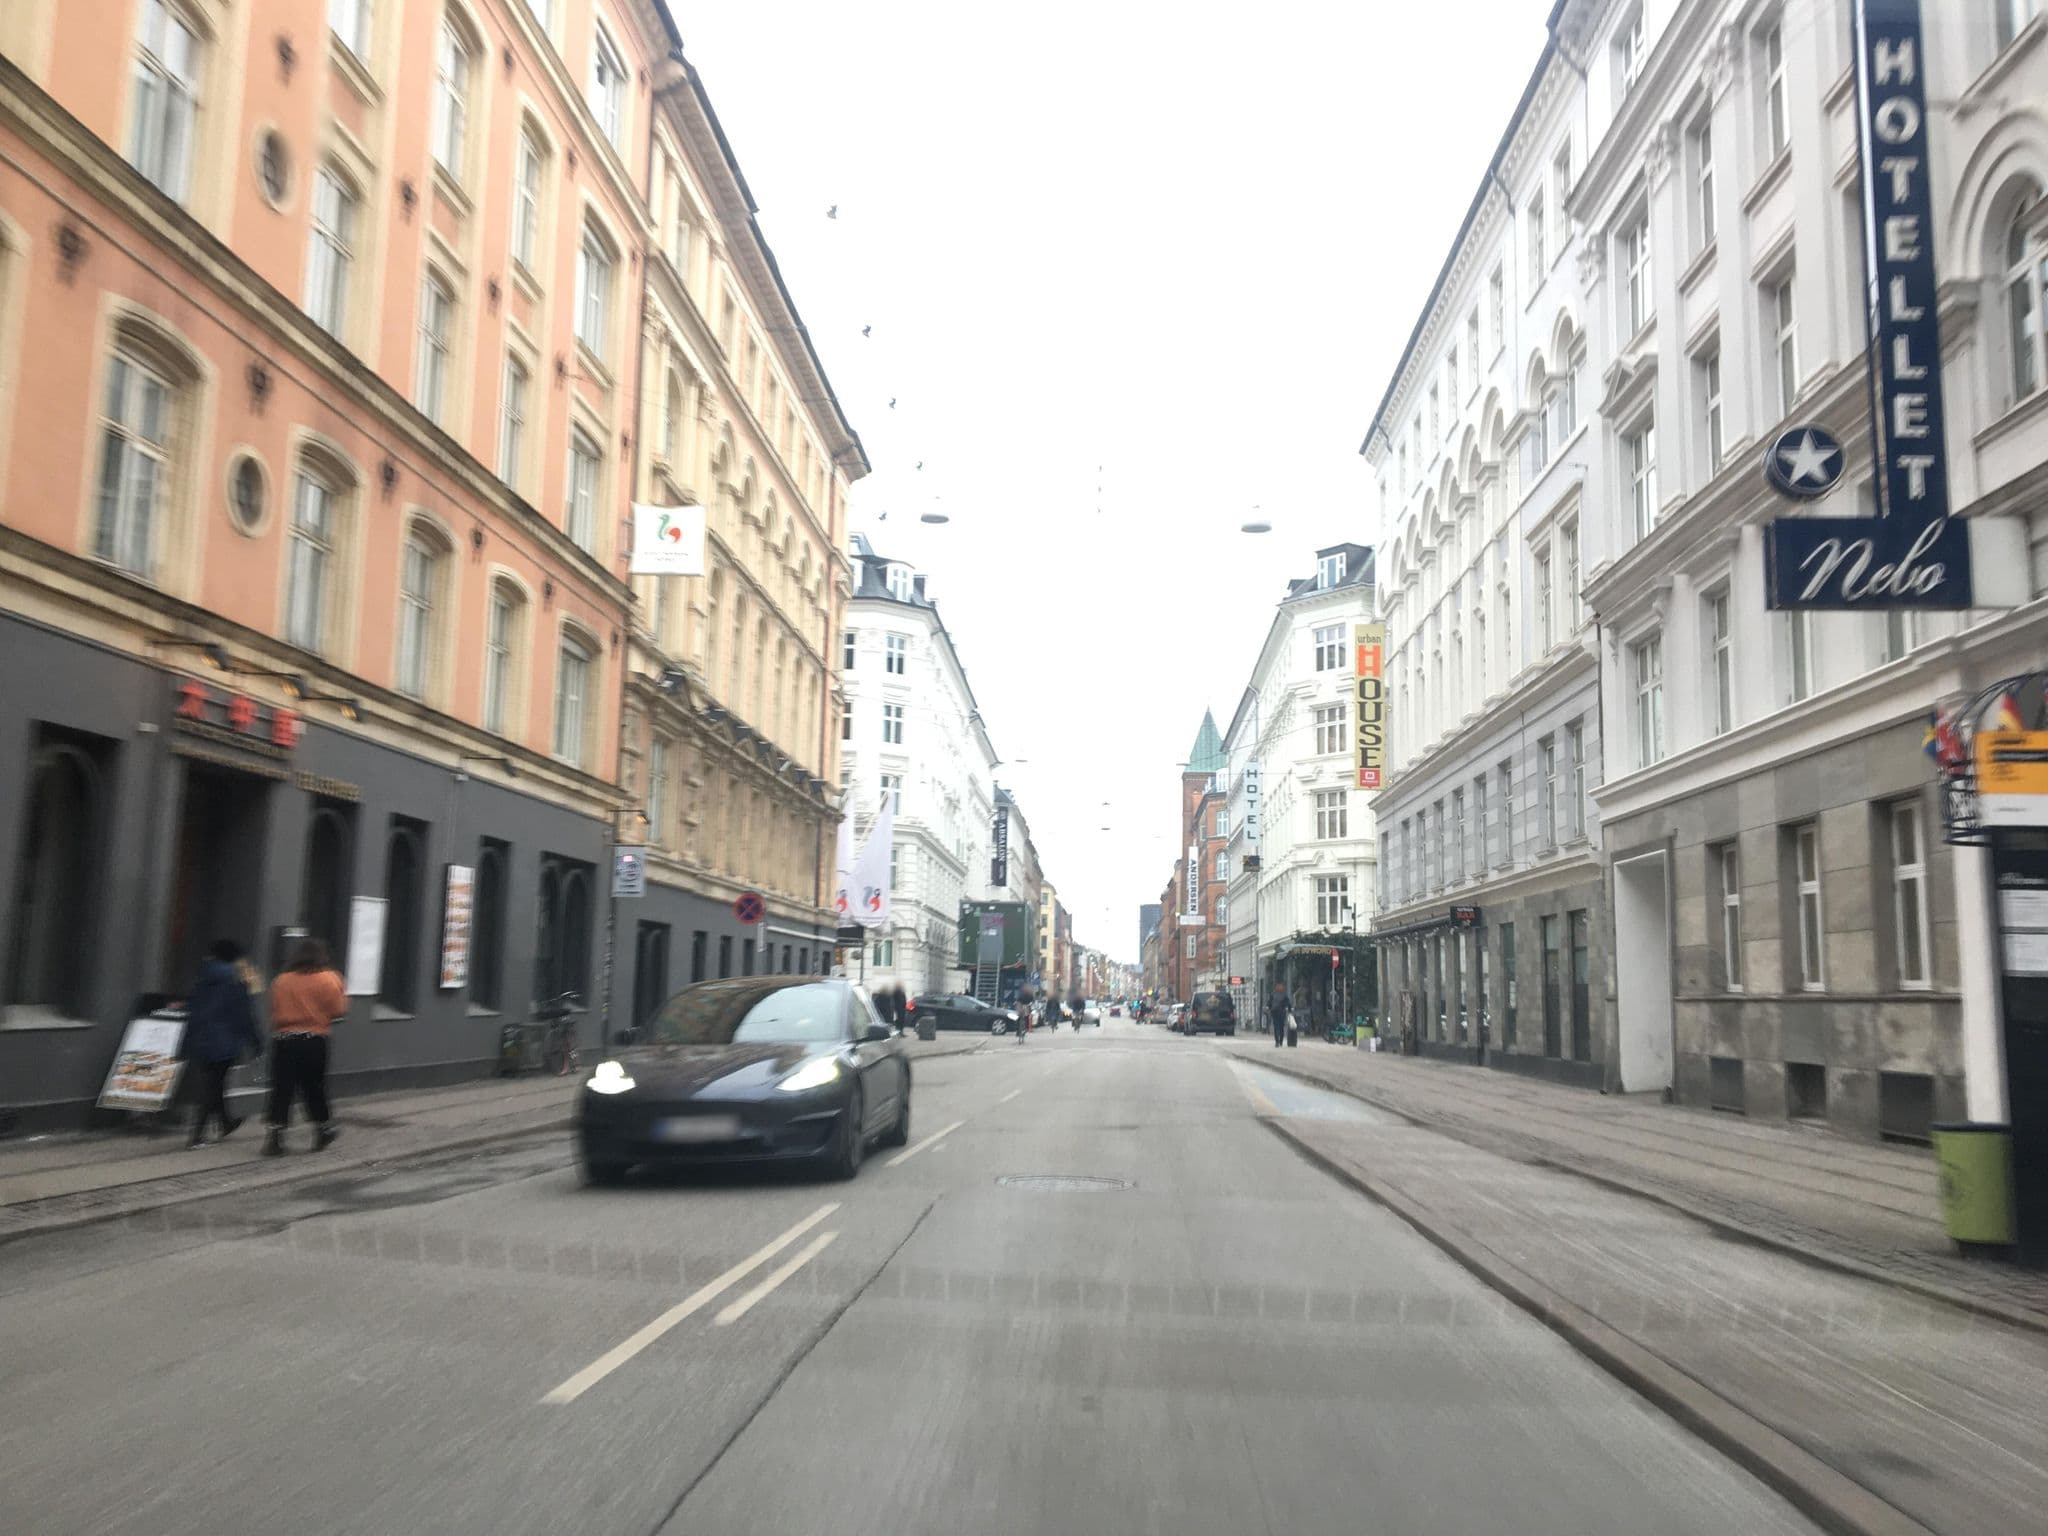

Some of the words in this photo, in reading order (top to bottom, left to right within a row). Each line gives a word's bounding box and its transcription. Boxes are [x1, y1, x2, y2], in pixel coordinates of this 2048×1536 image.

[1874, 38, 1934, 500] HOTELLET
[1799, 516, 1947, 602] Nebo
[1357, 633, 1381, 643] urban
[1357, 644, 1382, 769] HOUSE
[1246, 769, 1258, 840] HOTEL
